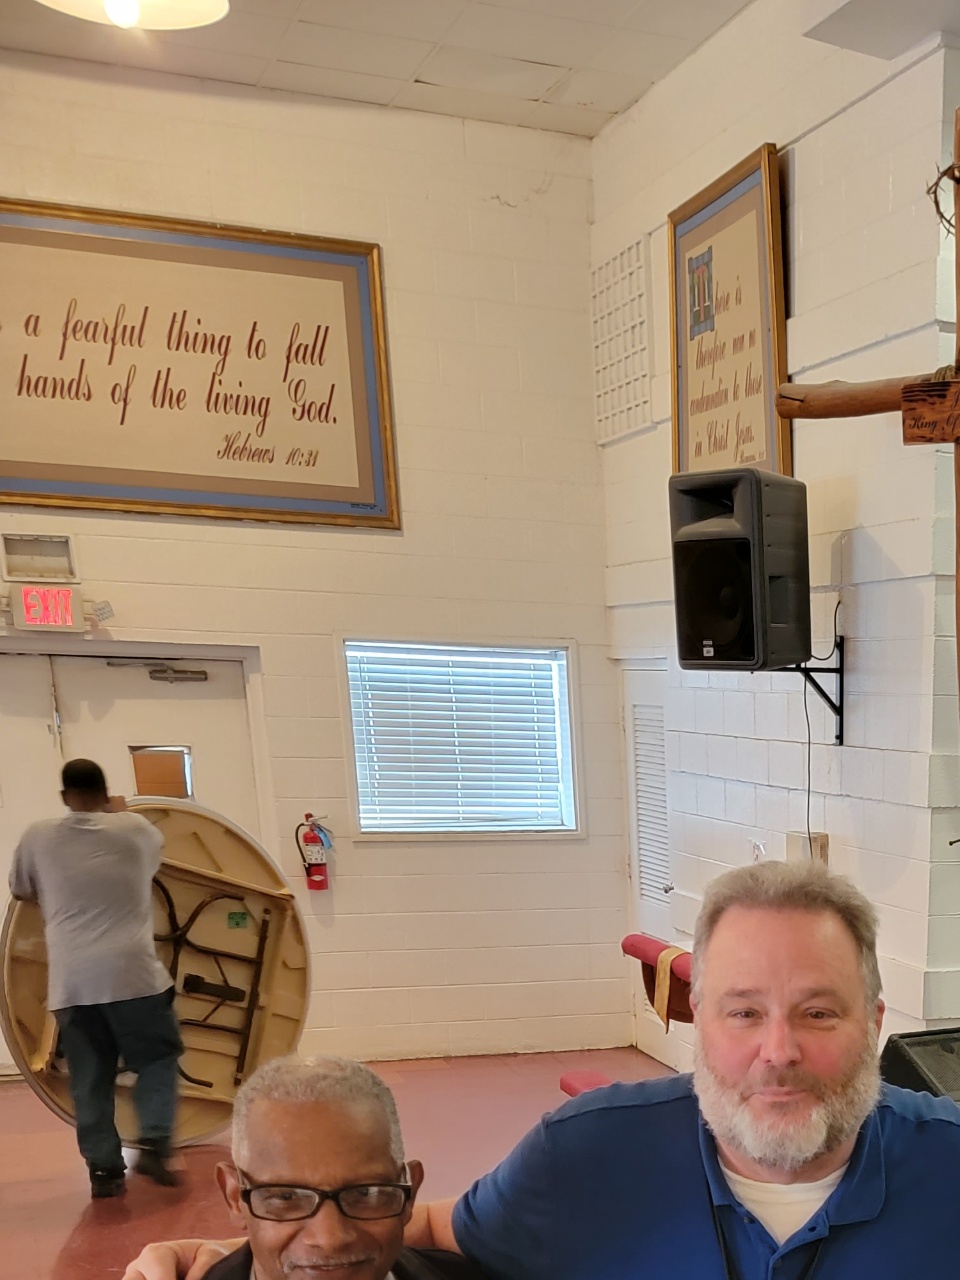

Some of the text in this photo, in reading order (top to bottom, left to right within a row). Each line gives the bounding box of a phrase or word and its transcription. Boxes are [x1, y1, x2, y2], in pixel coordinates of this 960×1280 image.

[24, 298, 330, 383] a fearful thing to fall
[16, 353, 337, 437] hands of the living God.
[909, 416, 938, 434] King
[945, 412, 958, 435] Of
[216, 431, 319, 467] Hebrews 10:31
[22, 587, 73, 626] EXIT
